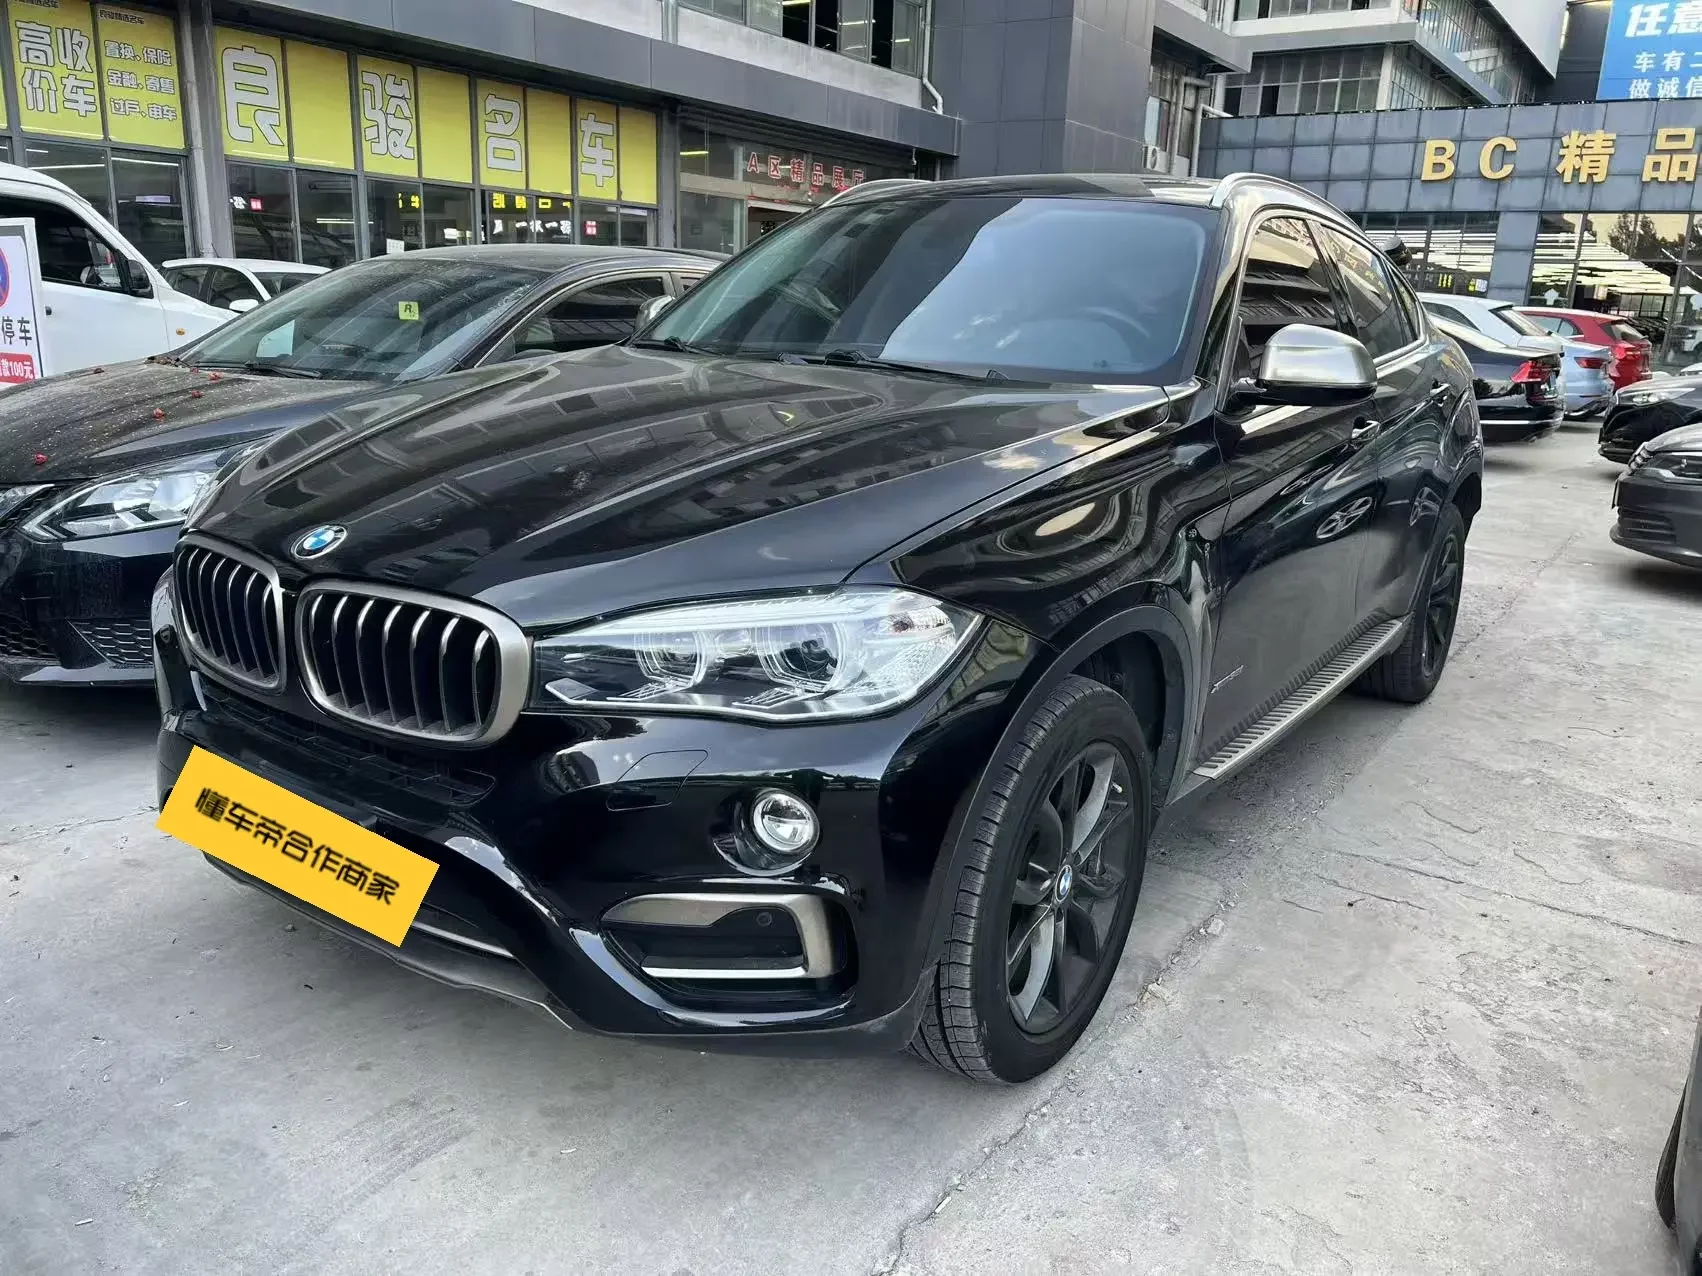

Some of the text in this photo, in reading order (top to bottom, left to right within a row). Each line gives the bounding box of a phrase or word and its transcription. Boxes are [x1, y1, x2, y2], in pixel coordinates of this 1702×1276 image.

[1625, 0, 1702, 37] 任意
[1, 315, 33, 347] 停车
[0, 358, 34, 380] 款100元
